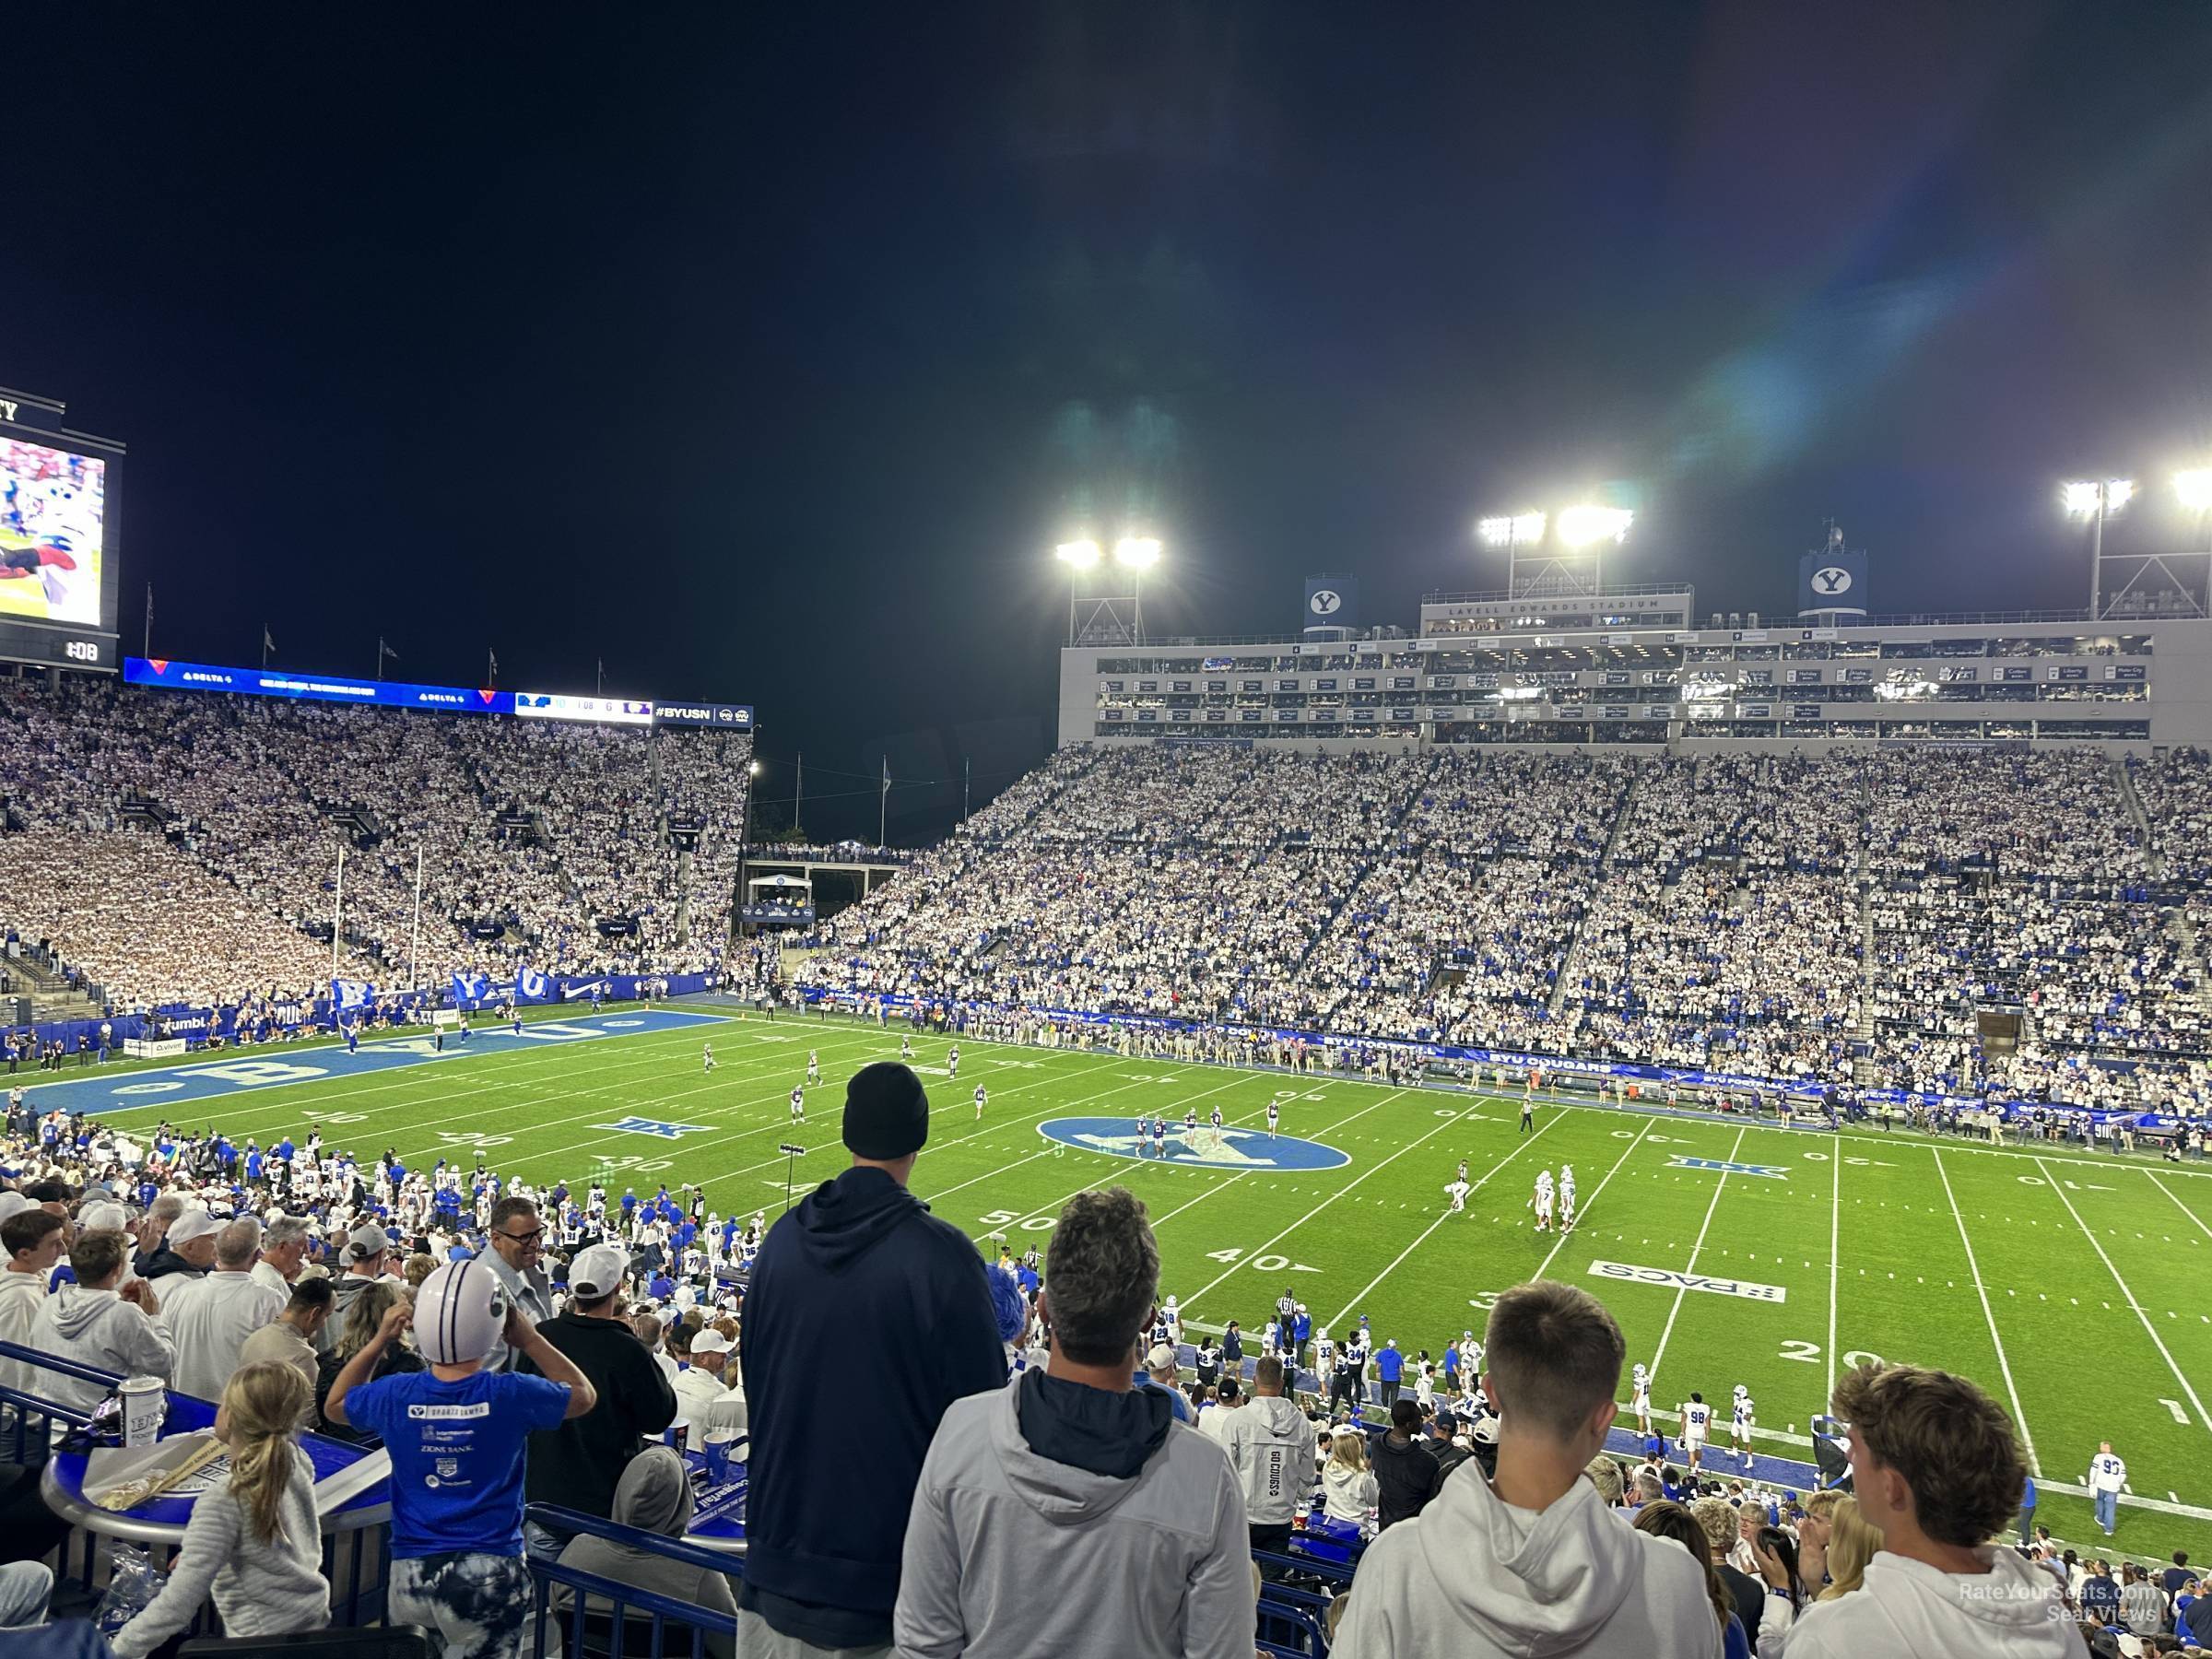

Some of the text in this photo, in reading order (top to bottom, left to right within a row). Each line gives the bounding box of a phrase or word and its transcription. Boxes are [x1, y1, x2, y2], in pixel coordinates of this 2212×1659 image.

[1818, 571, 1845, 592] Y
[1315, 594, 1335, 611] Y
[1449, 601, 1658, 616] LAVELL EDWARDS STADIUM
[66, 641, 98, 661] 1:08
[193, 672, 224, 683] DELTA
[428, 694, 457, 703] DELTA
[656, 707, 711, 720] #BYUSN
[522, 968, 545, 997] U
[1324, 1036, 1354, 1047] BYU
[1489, 1053, 1611, 1074] BYU COUGARS
[439, 1132, 514, 1147] 20
[603, 1156, 674, 1171] 30
[305, 1175, 314, 1183] 53
[978, 1209, 1058, 1230] 50
[567, 1231, 576, 1241] 91
[710, 1227, 720, 1236] 43
[745, 1247, 756, 1256] 96
[688, 1256, 699, 1267] 77
[1206, 1248, 1289, 1271] 40
[1602, 1265, 1738, 1293] PACS
[1165, 1312, 1174, 1324] 18
[1157, 1327, 1168, 1337] 29
[1320, 1347, 1331, 1358] 33
[1348, 1347, 1360, 1359] 34
[1778, 1340, 1885, 1371] 20
[1284, 1356, 1294, 1367] 49
[1690, 1411, 1705, 1424] 98
[420, 1444, 473, 1453] ZIONS BANK
[1269, 1451, 1280, 1489] GO COUGS
